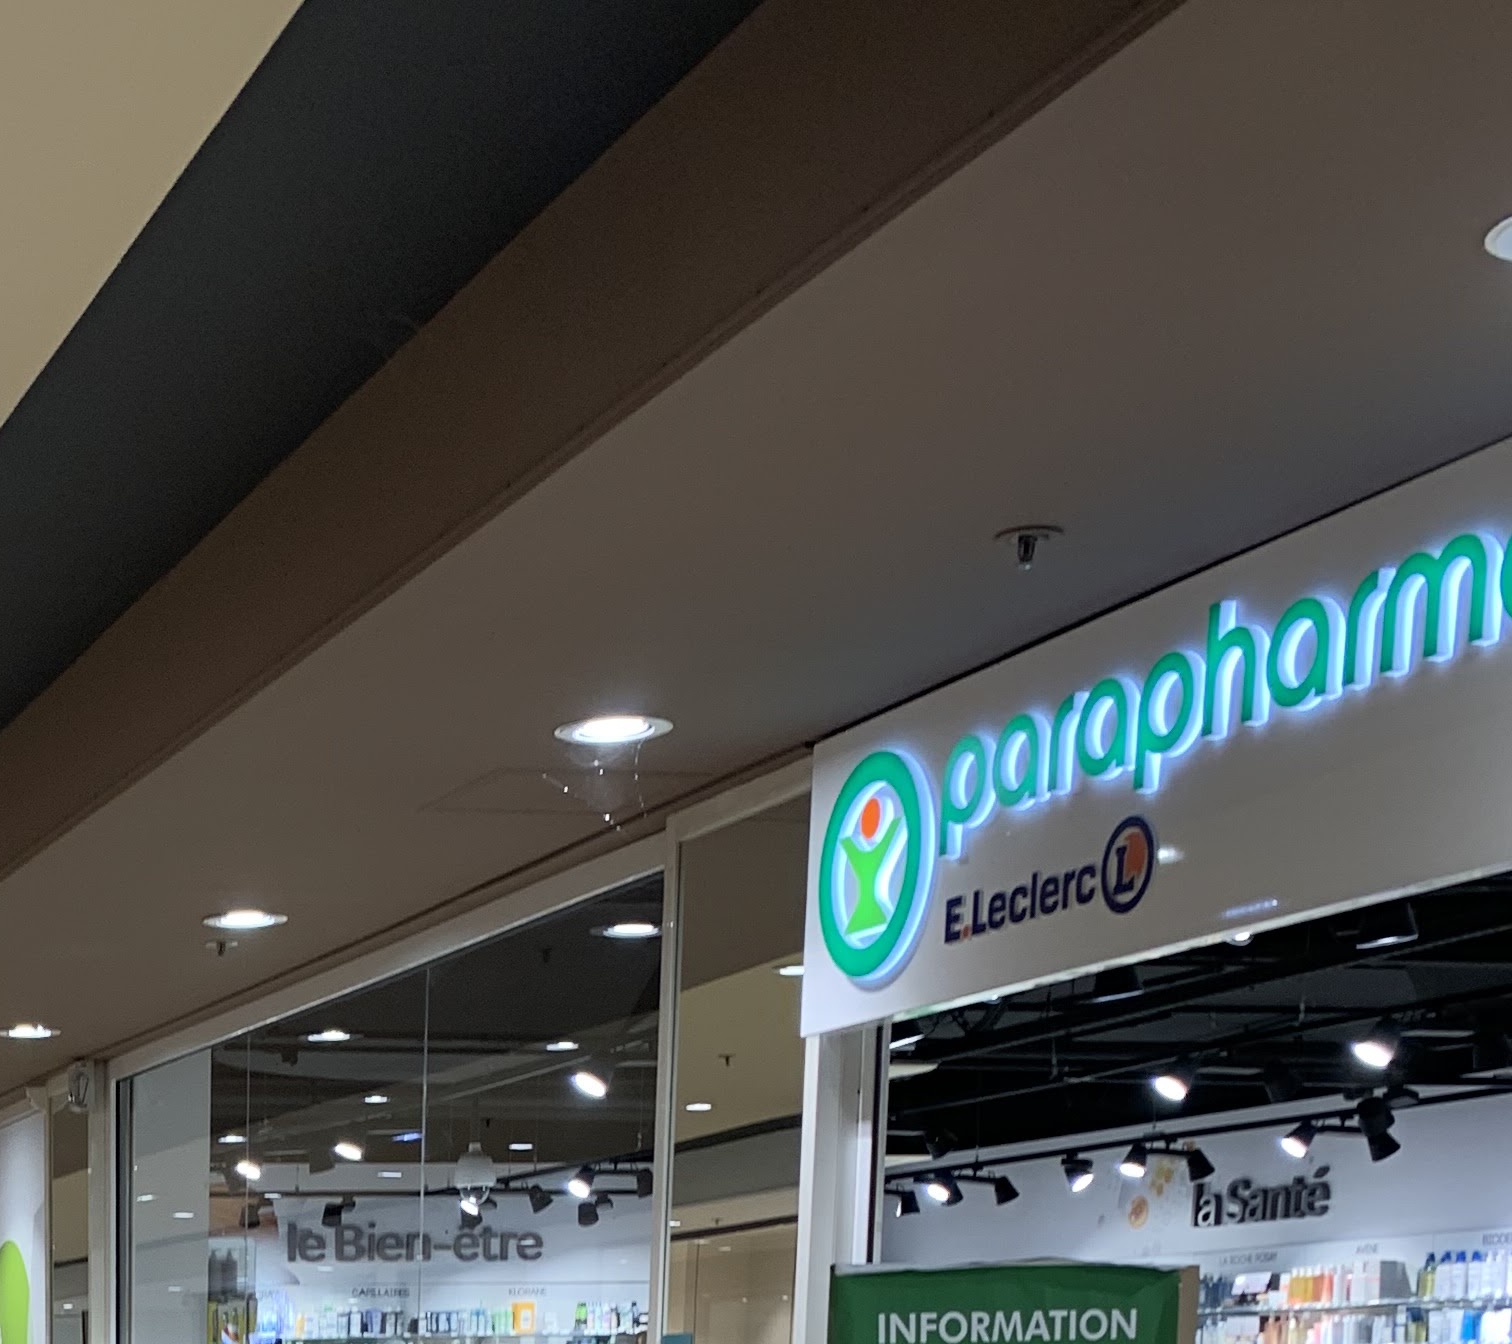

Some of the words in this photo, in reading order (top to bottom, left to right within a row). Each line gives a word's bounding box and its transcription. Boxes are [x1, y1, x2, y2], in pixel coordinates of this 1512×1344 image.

[945, 863, 1098, 944] E.Leclerc
[1191, 1181, 1222, 1227] la
[1226, 1165, 1331, 1224] Santé
[288, 1221, 327, 1262] le
[334, 1220, 544, 1263] Bien-être
